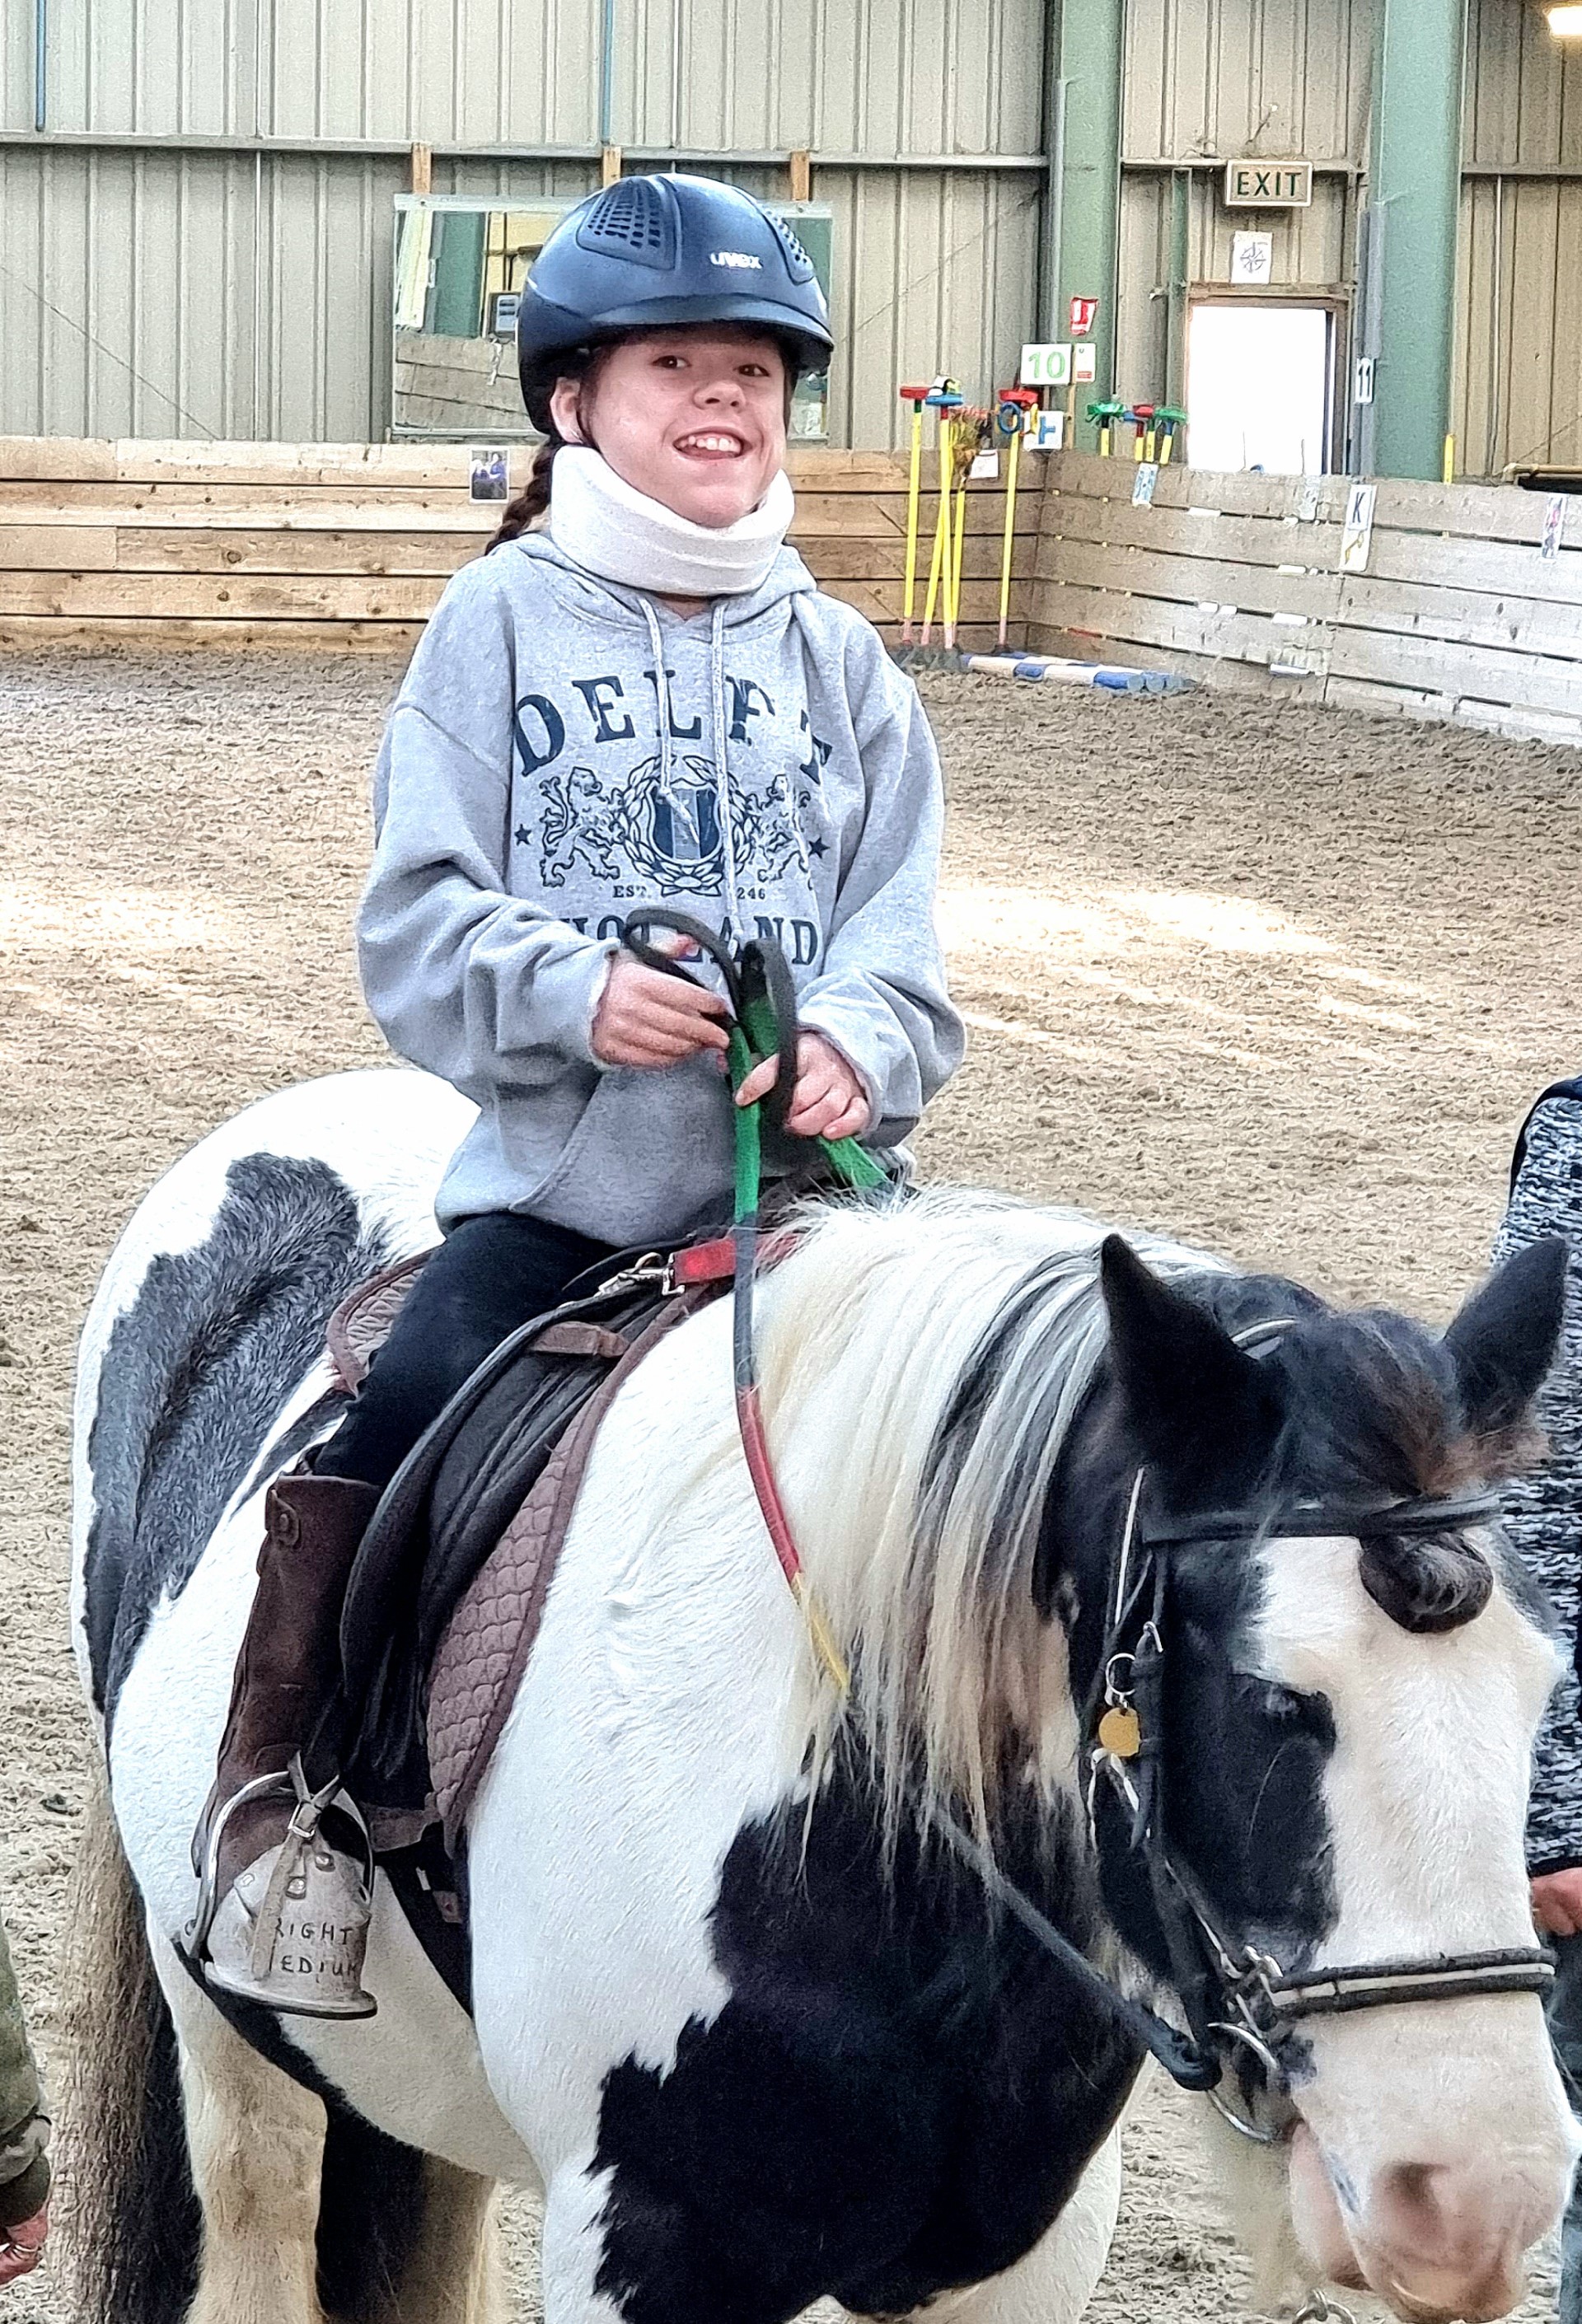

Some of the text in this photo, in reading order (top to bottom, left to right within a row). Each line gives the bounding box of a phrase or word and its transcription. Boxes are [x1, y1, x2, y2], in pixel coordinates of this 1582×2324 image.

[1237, 171, 1303, 197] EXIT
[1027, 351, 1066, 380] 10
[1357, 363, 1372, 397] 11
[1351, 491, 1367, 524] K
[734, 886, 767, 901] 246
[559, 914, 819, 966] OAND
[274, 1917, 354, 1945] RIGHT
[280, 1953, 363, 1982] EDIUM
